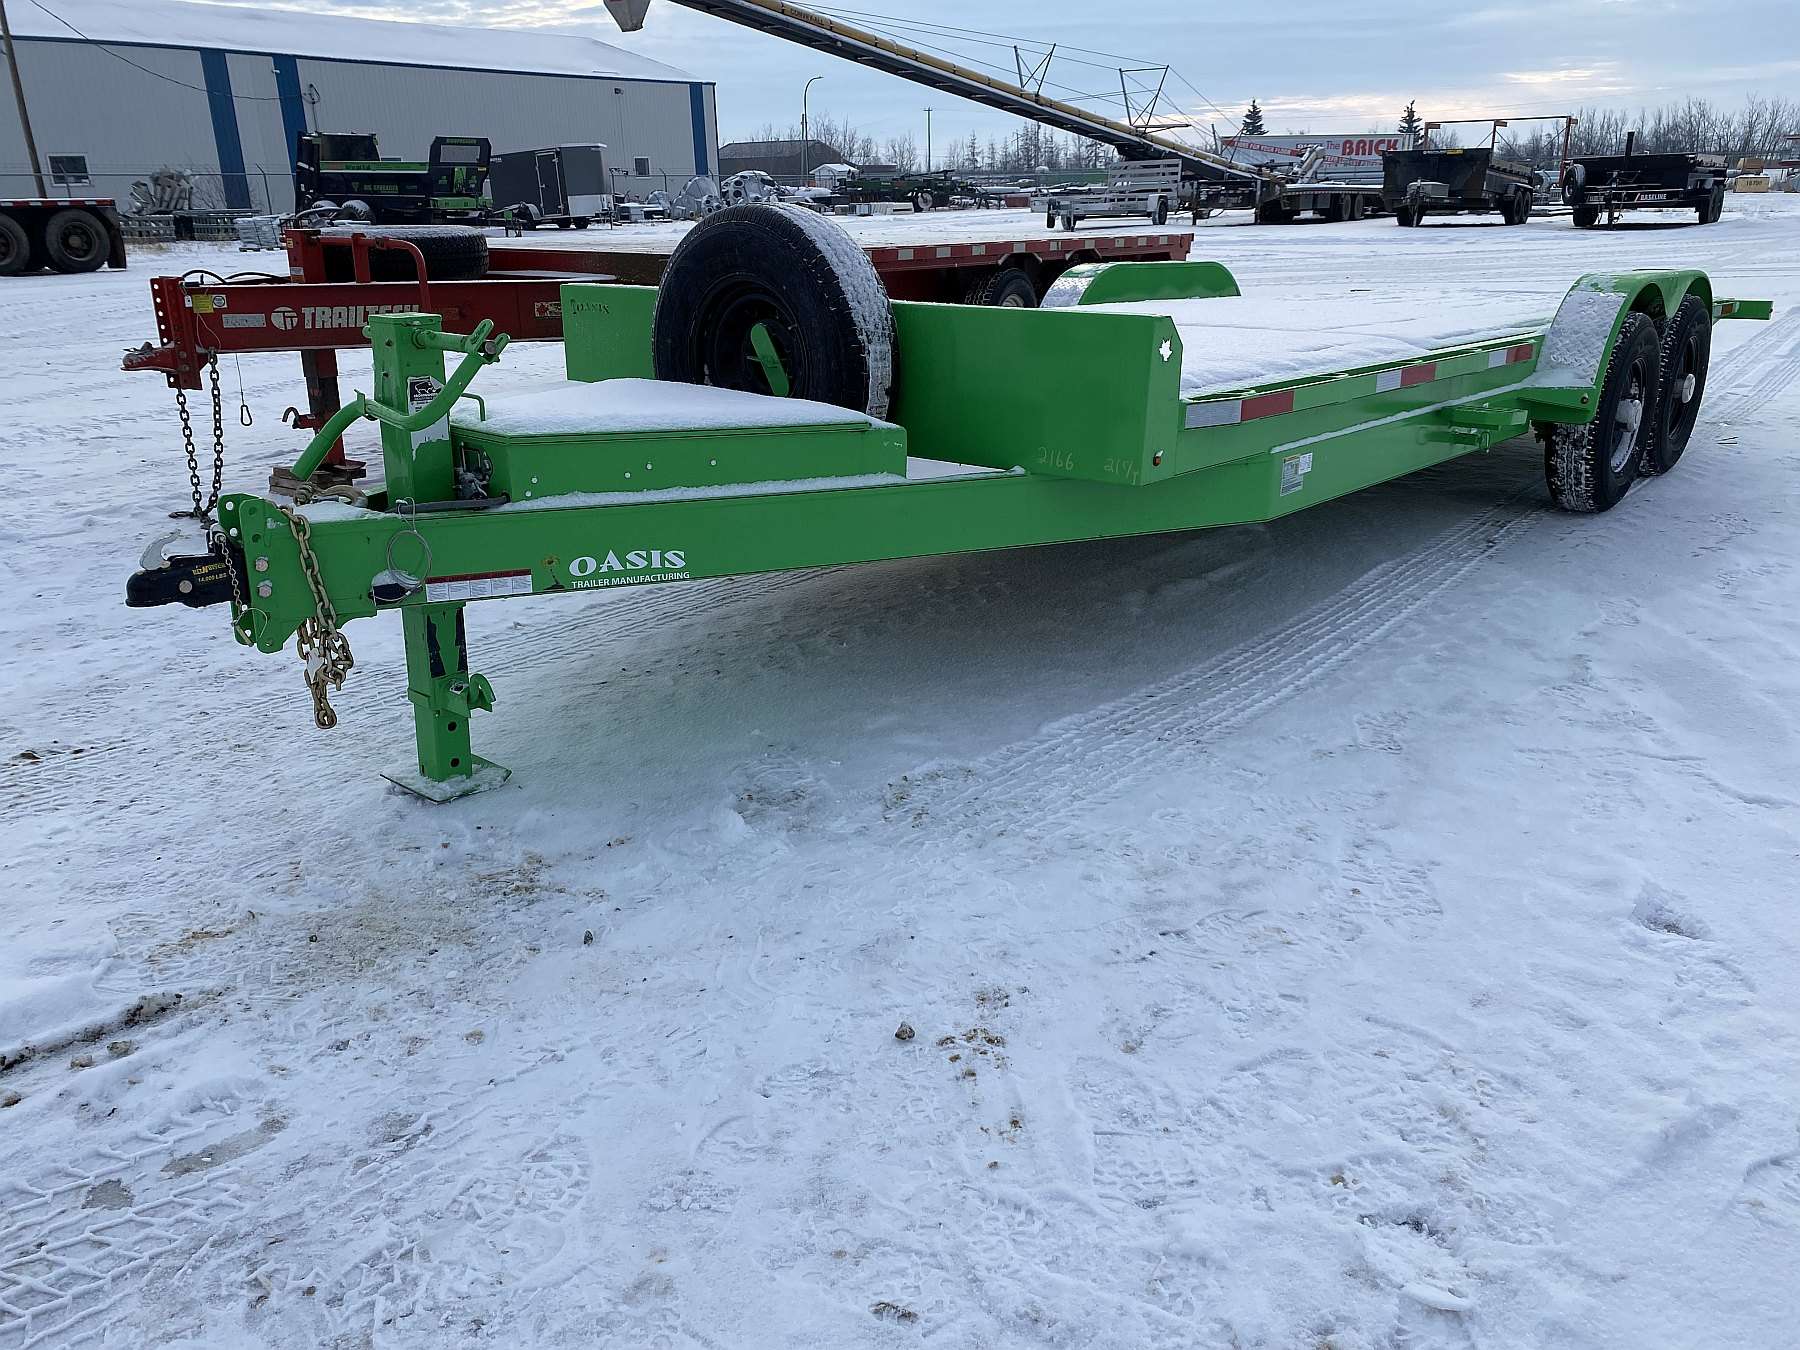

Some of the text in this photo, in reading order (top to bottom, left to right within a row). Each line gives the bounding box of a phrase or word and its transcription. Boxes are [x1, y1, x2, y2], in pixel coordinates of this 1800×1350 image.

[1326, 140, 1340, 150] The
[1342, 138, 1399, 156] BRICK
[1640, 193, 1667, 201] BASELINE
[1039, 446, 1074, 471] 2166
[568, 549, 687, 577] OASIS
[571, 571, 690, 589] TRAILER MANUFACTURING
